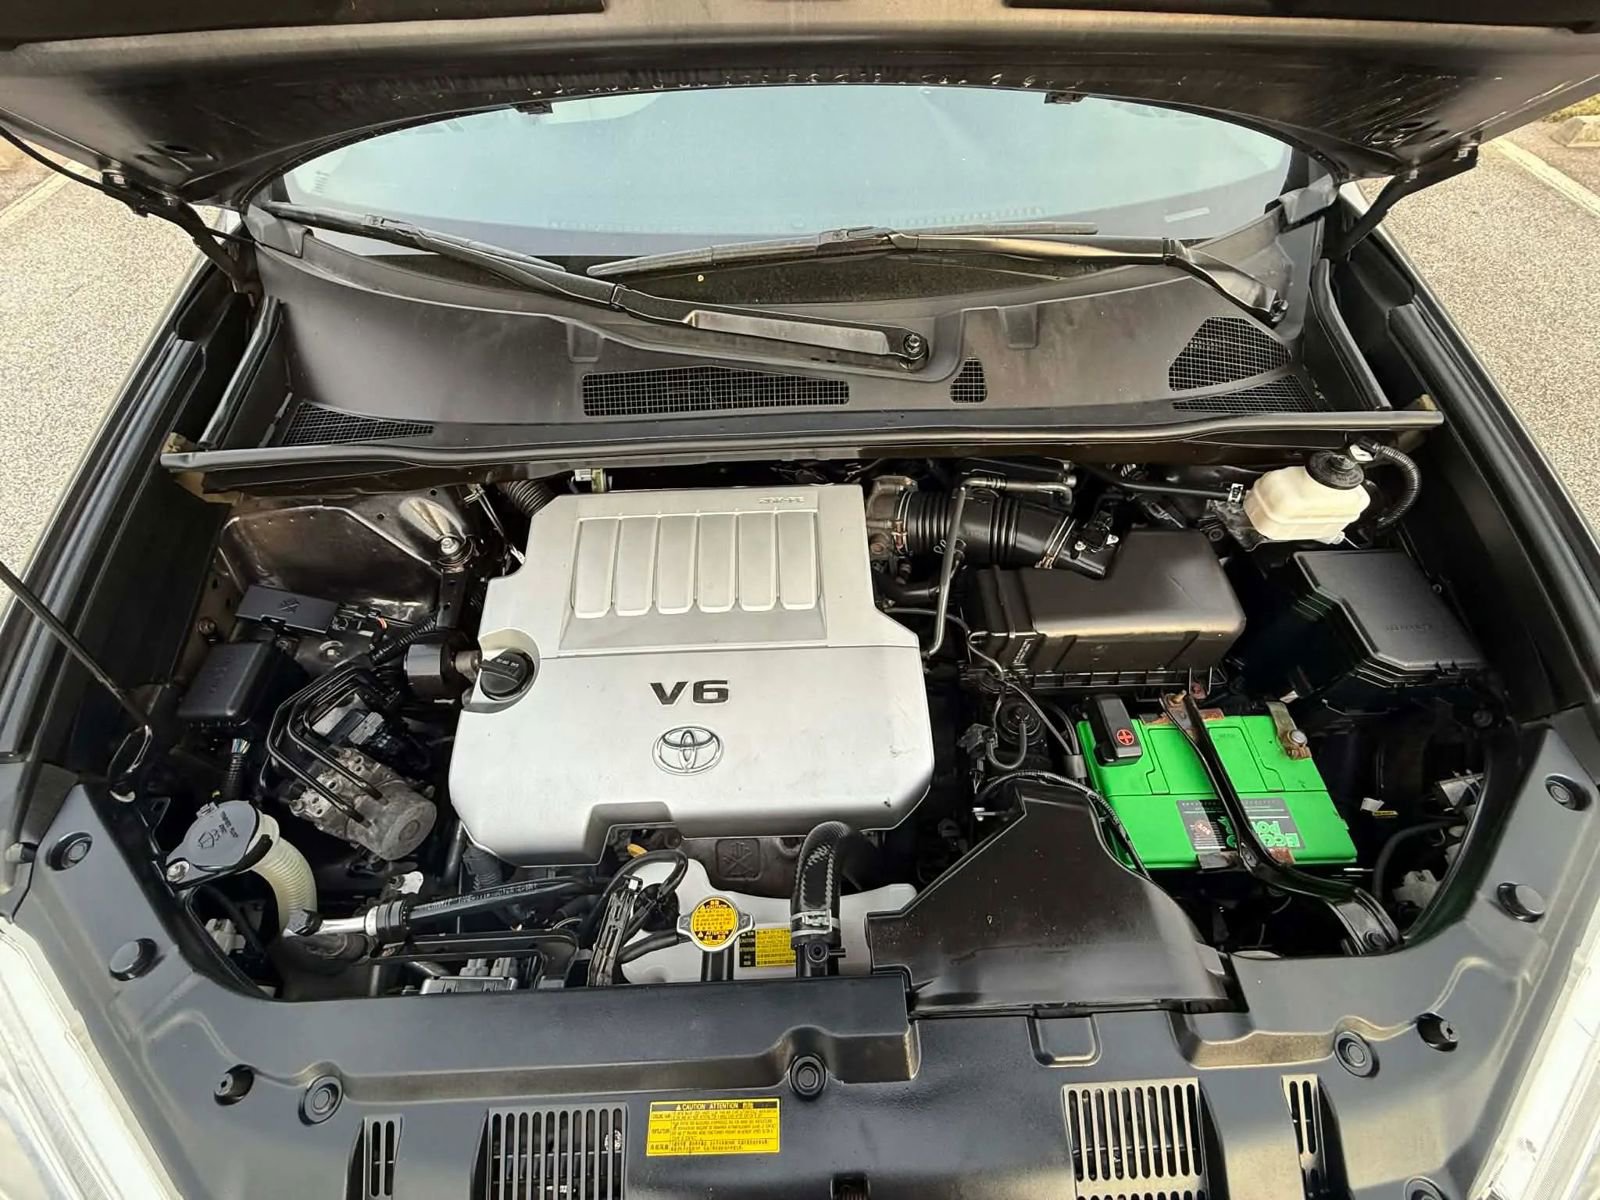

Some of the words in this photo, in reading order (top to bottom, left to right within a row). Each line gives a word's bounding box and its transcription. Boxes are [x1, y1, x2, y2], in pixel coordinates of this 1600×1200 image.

[650, 680, 729, 705] V6
[682, 1103, 705, 1111] CAUTION
[709, 1102, 739, 1110] ATTENTION
